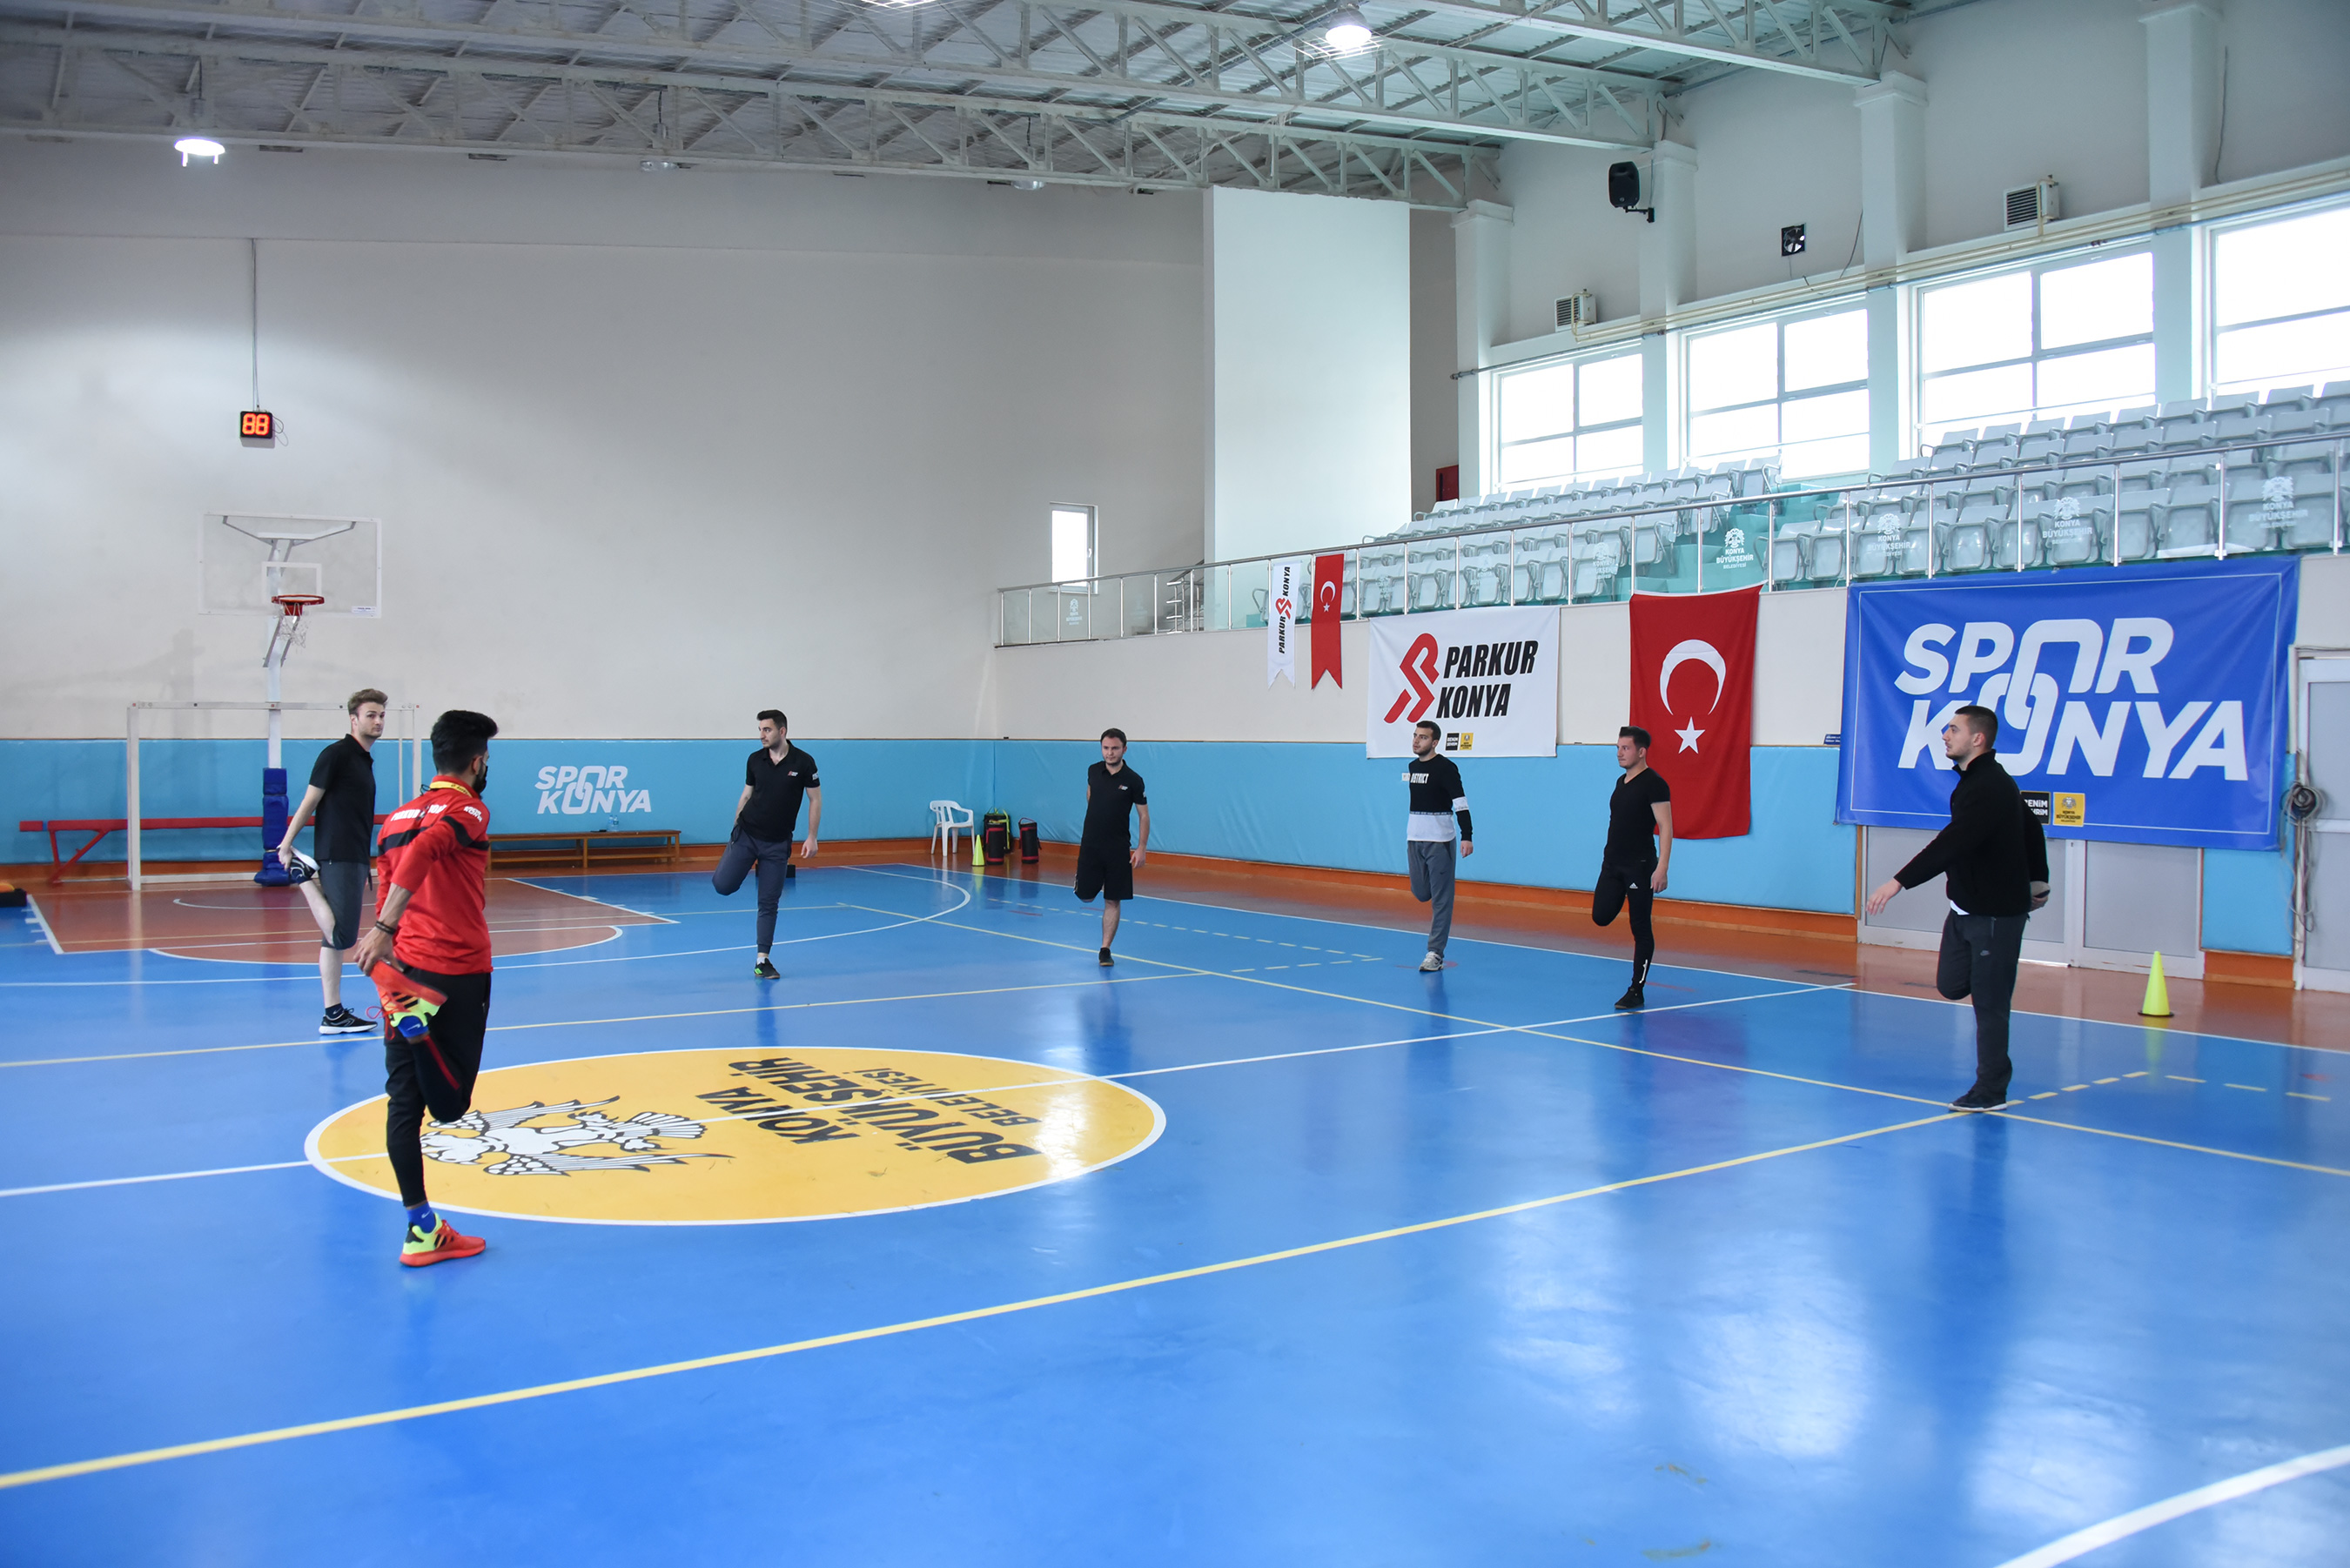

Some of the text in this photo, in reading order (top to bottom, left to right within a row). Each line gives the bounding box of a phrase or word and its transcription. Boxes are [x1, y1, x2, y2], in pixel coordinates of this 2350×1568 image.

[242, 412, 271, 436] 88
[2054, 519, 2081, 528] KONYA
[1716, 553, 1755, 564] BÜYÜKŞEHİR
[1282, 566, 1291, 597] KONYA
[1443, 640, 1539, 679] PARKUR
[1894, 617, 2175, 730] SPOR
[1435, 683, 1512, 719] KONYA
[534, 765, 628, 800] SPOR
[536, 781, 652, 814] KONYA
[695, 1086, 862, 1145] KONYA
[728, 1056, 1044, 1164] BÜYÜKŞEHİR
